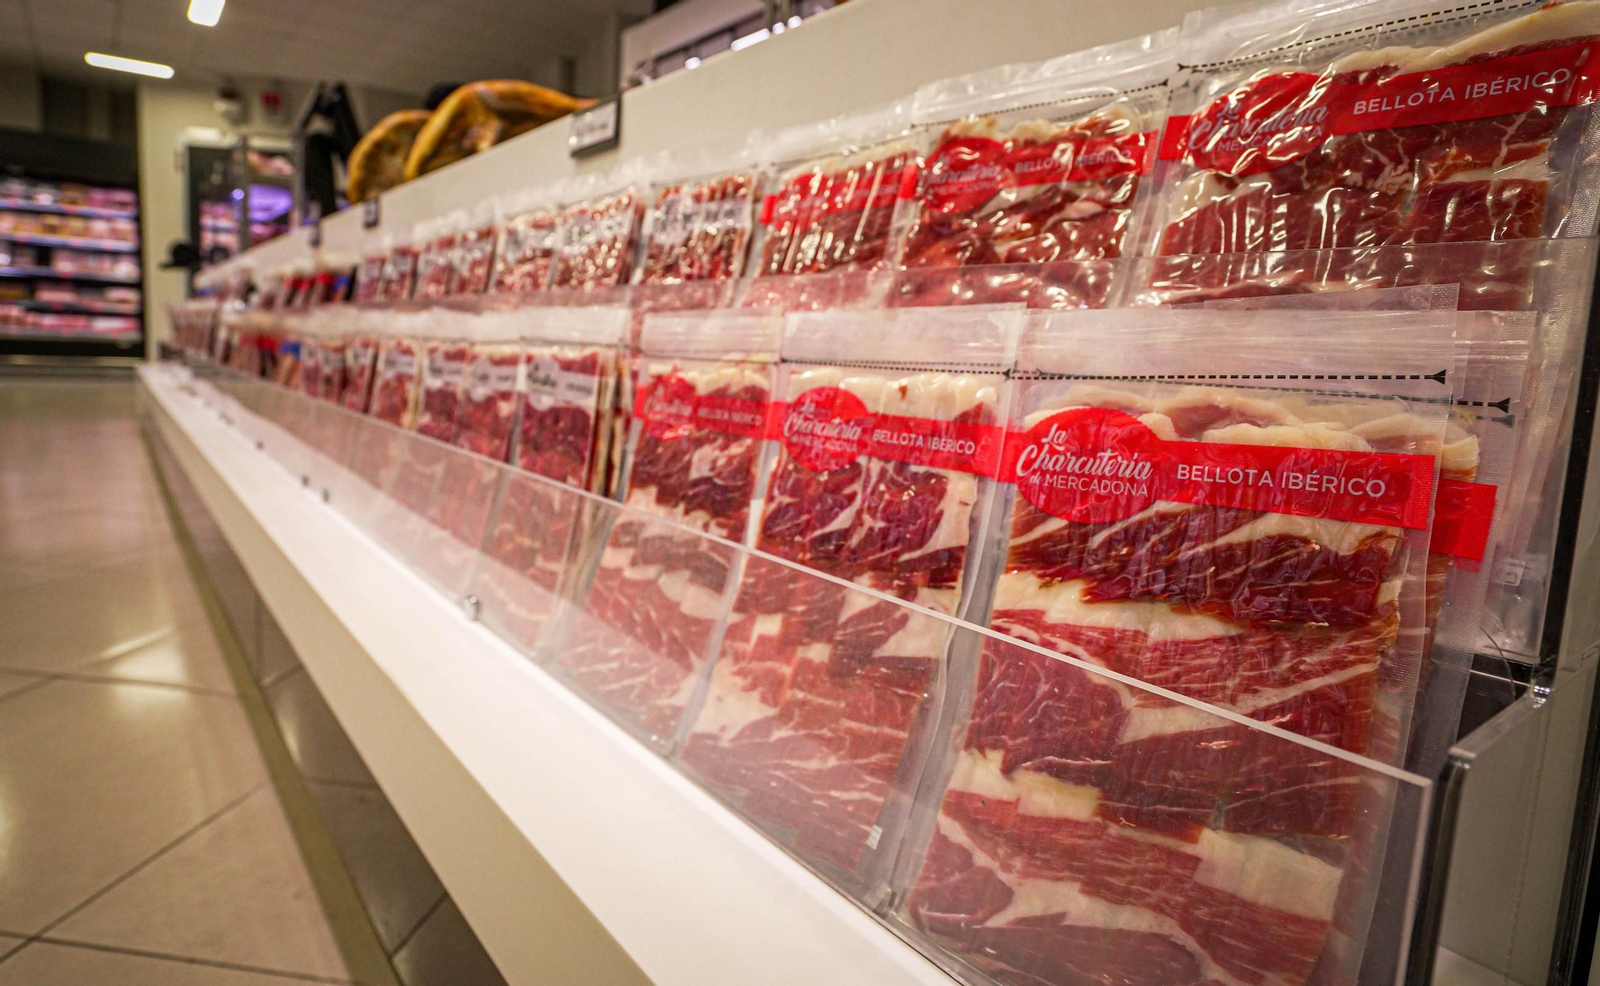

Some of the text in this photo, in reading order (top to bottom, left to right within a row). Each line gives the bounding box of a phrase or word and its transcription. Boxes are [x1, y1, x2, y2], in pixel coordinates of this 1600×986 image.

[1353, 67, 1571, 115] BELLOTA IBÉRICO
[872, 429, 923, 447] BELLOTA
[1041, 423, 1067, 450] La
[1016, 443, 1153, 480] Charcutería
[1045, 475, 1149, 497] MERCADONA
[1177, 463, 1386, 498] BELLOTA IBÉRICO
